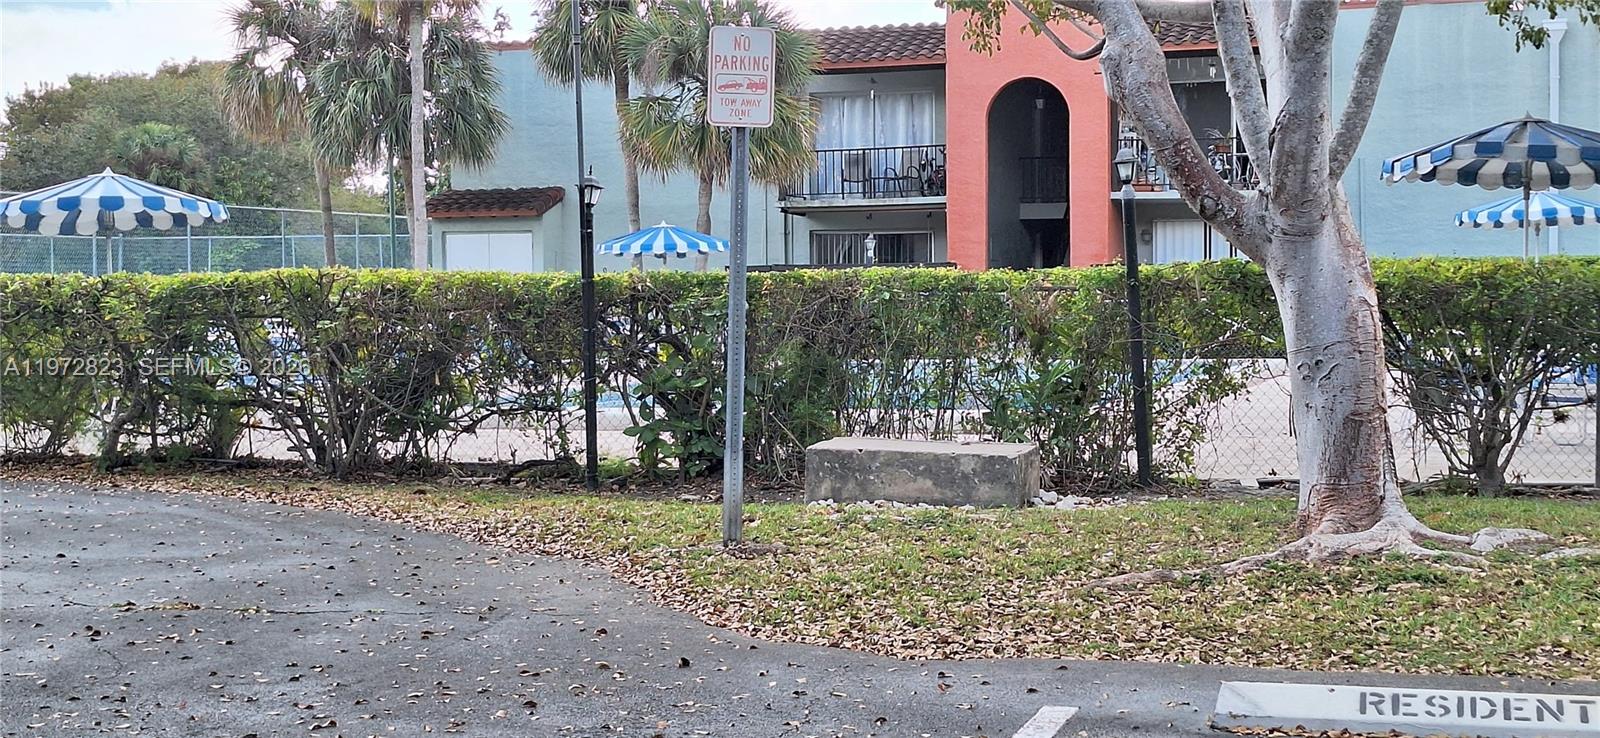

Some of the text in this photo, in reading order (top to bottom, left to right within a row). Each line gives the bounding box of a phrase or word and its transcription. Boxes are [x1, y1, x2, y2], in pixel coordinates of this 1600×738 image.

[734, 36, 751, 51] NO
[714, 55, 769, 71] PARKING
[720, 98, 762, 108] TOW AWAY
[729, 109, 751, 117] ZONE
[1359, 691, 1597, 724] RESIDENT
